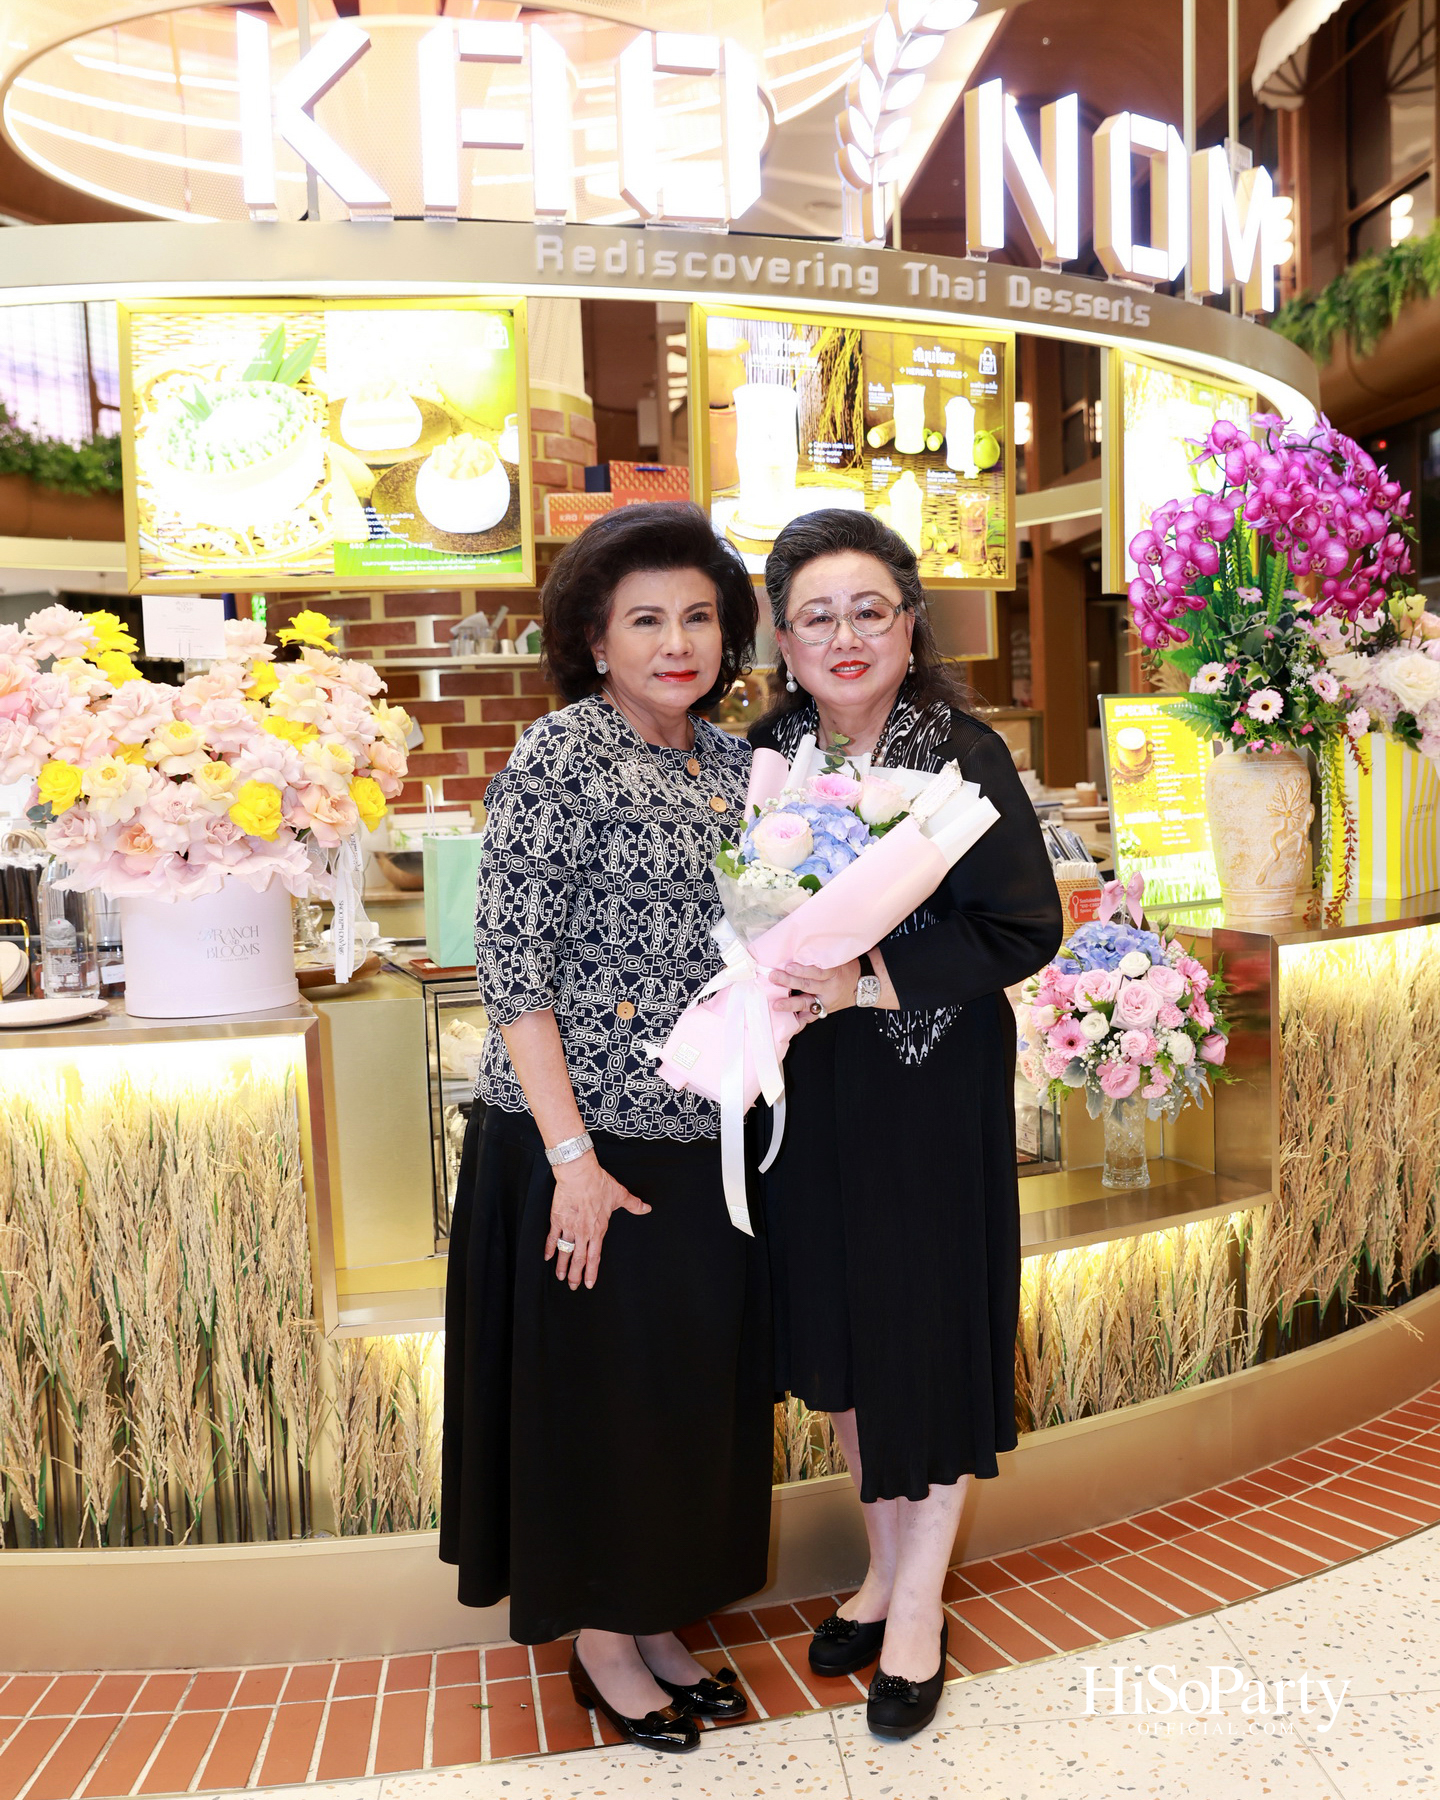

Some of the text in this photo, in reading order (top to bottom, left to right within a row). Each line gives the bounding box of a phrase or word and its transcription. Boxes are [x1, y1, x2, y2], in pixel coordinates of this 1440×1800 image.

[236, 10, 1275, 313] KAO NOM
[536, 235, 1151, 328] Rediscovering Thai Desserts
[559, 513, 578, 522] KAO
[198, 925, 259, 945] BRANCH
[206, 943, 260, 959] BLOOMS
